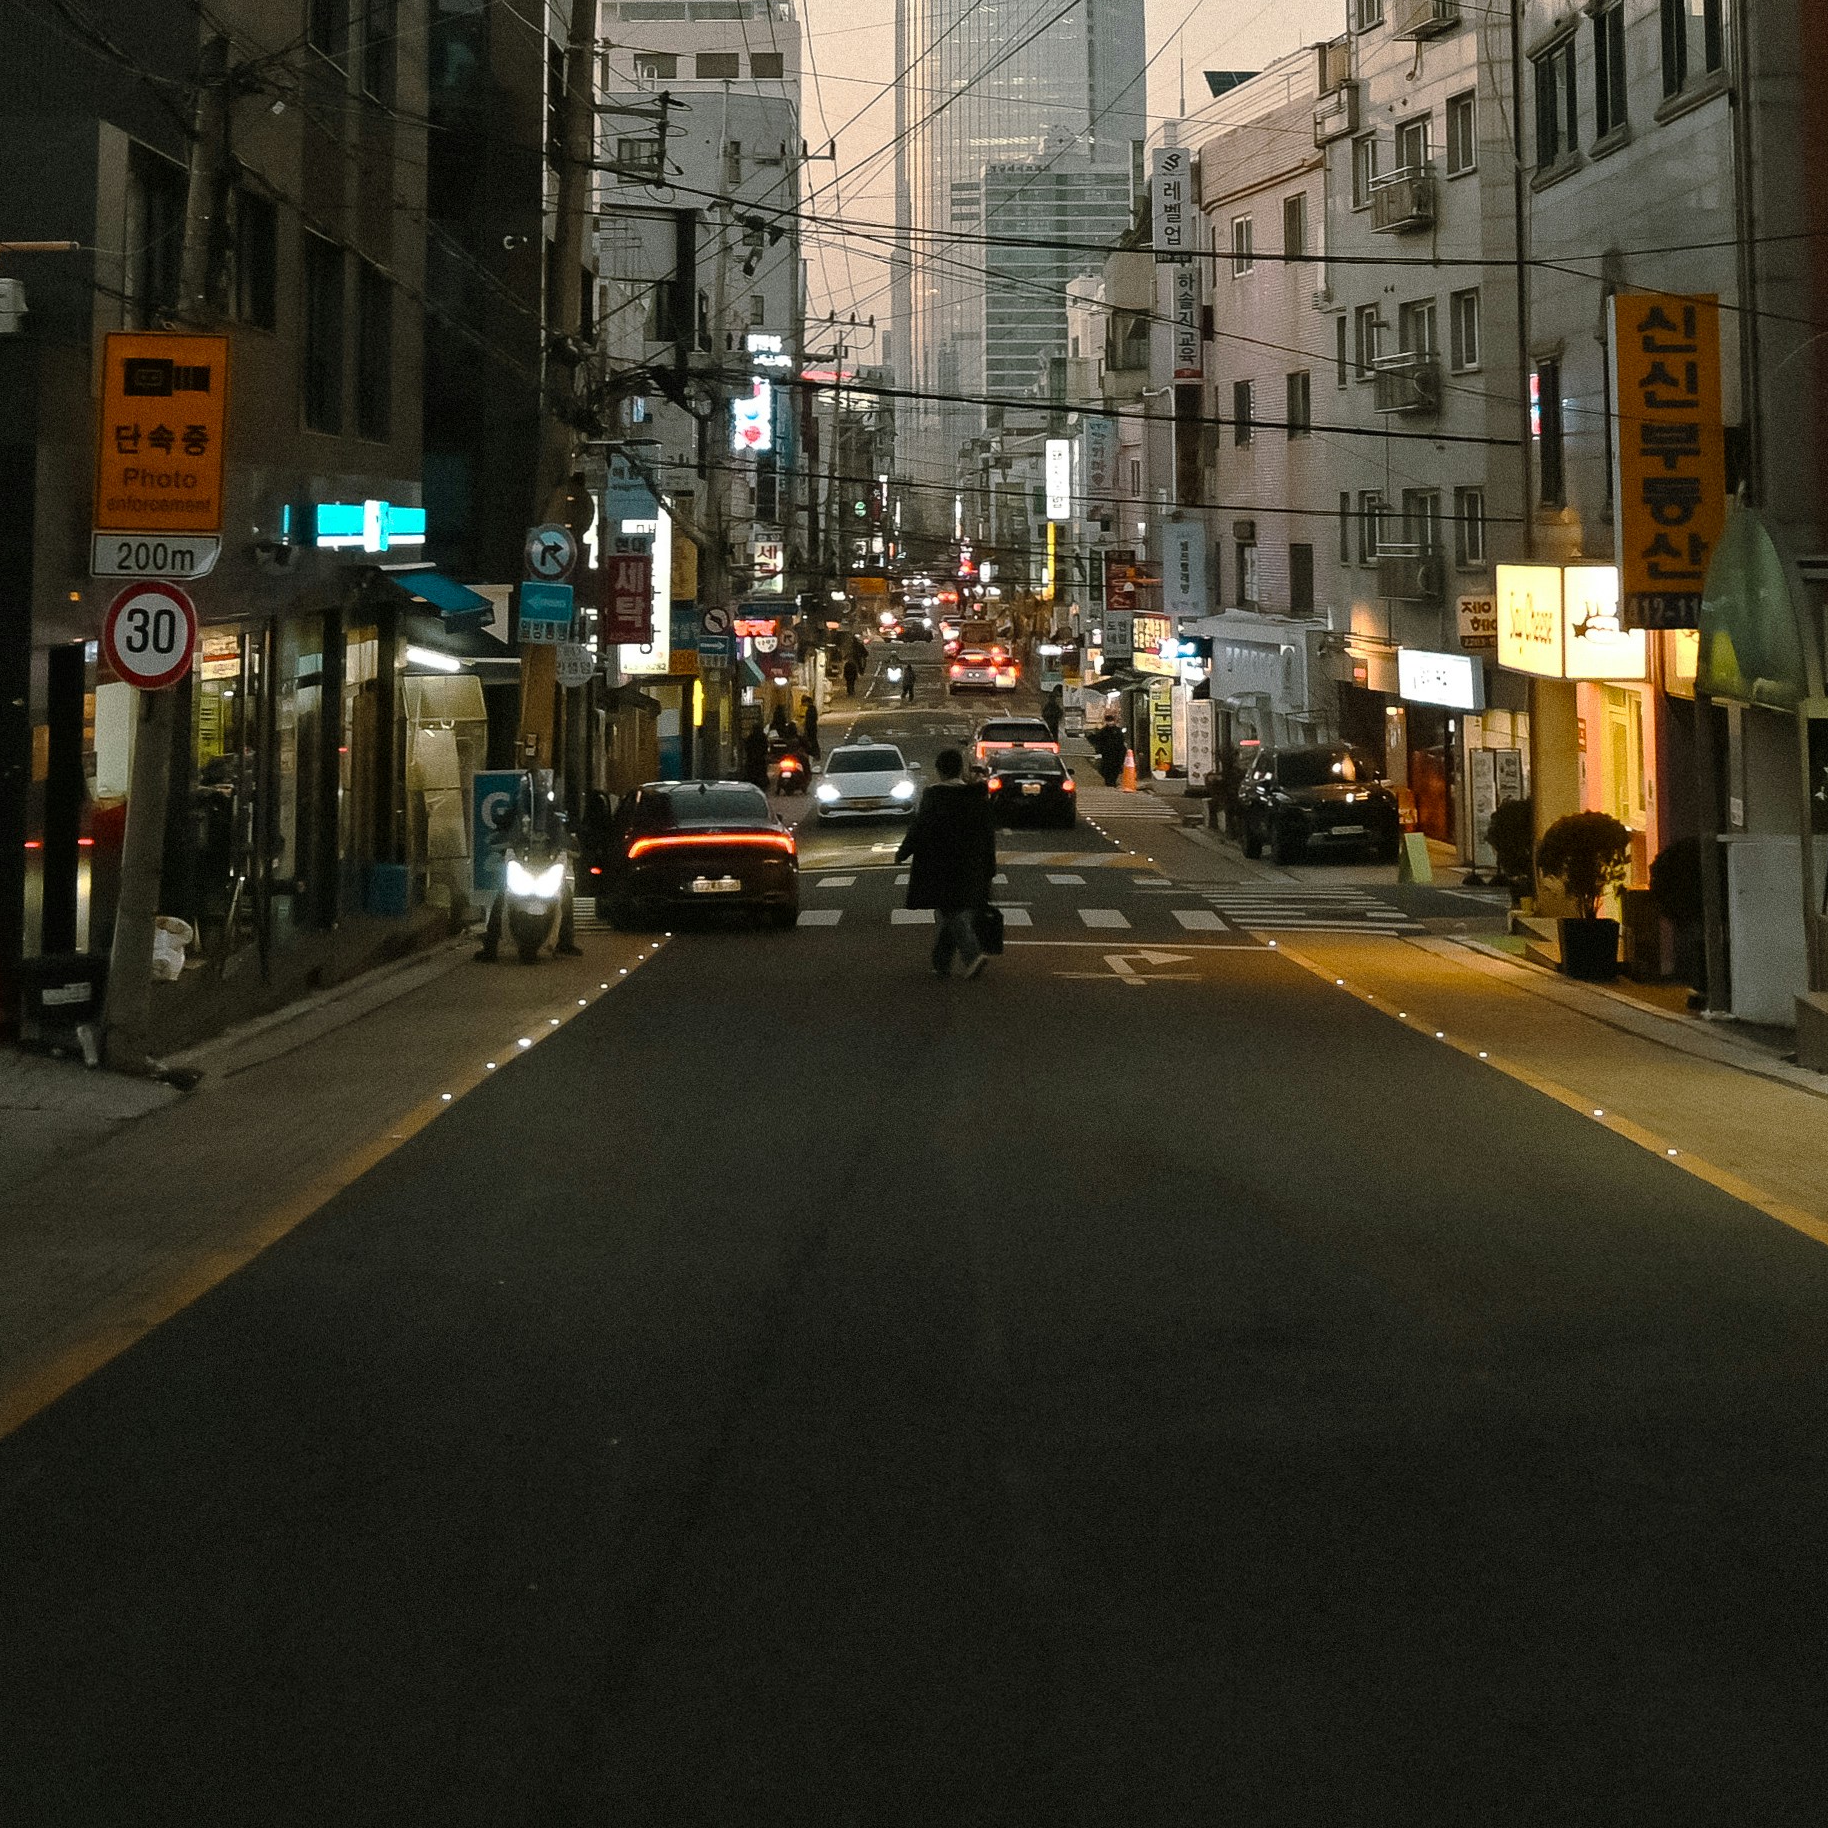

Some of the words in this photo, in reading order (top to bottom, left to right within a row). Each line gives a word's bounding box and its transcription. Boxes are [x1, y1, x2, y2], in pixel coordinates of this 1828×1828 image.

[1163, 180, 1181, 246] 레벨업
[115, 423, 209, 457] 단속중
[1636, 303, 1710, 583] 신신부동산
[123, 467, 197, 491] Photo
[106, 495, 212, 514] enforcement
[117, 542, 195, 571] 200m
[614, 561, 645, 628] 세탁
[125, 608, 176, 654] 30
